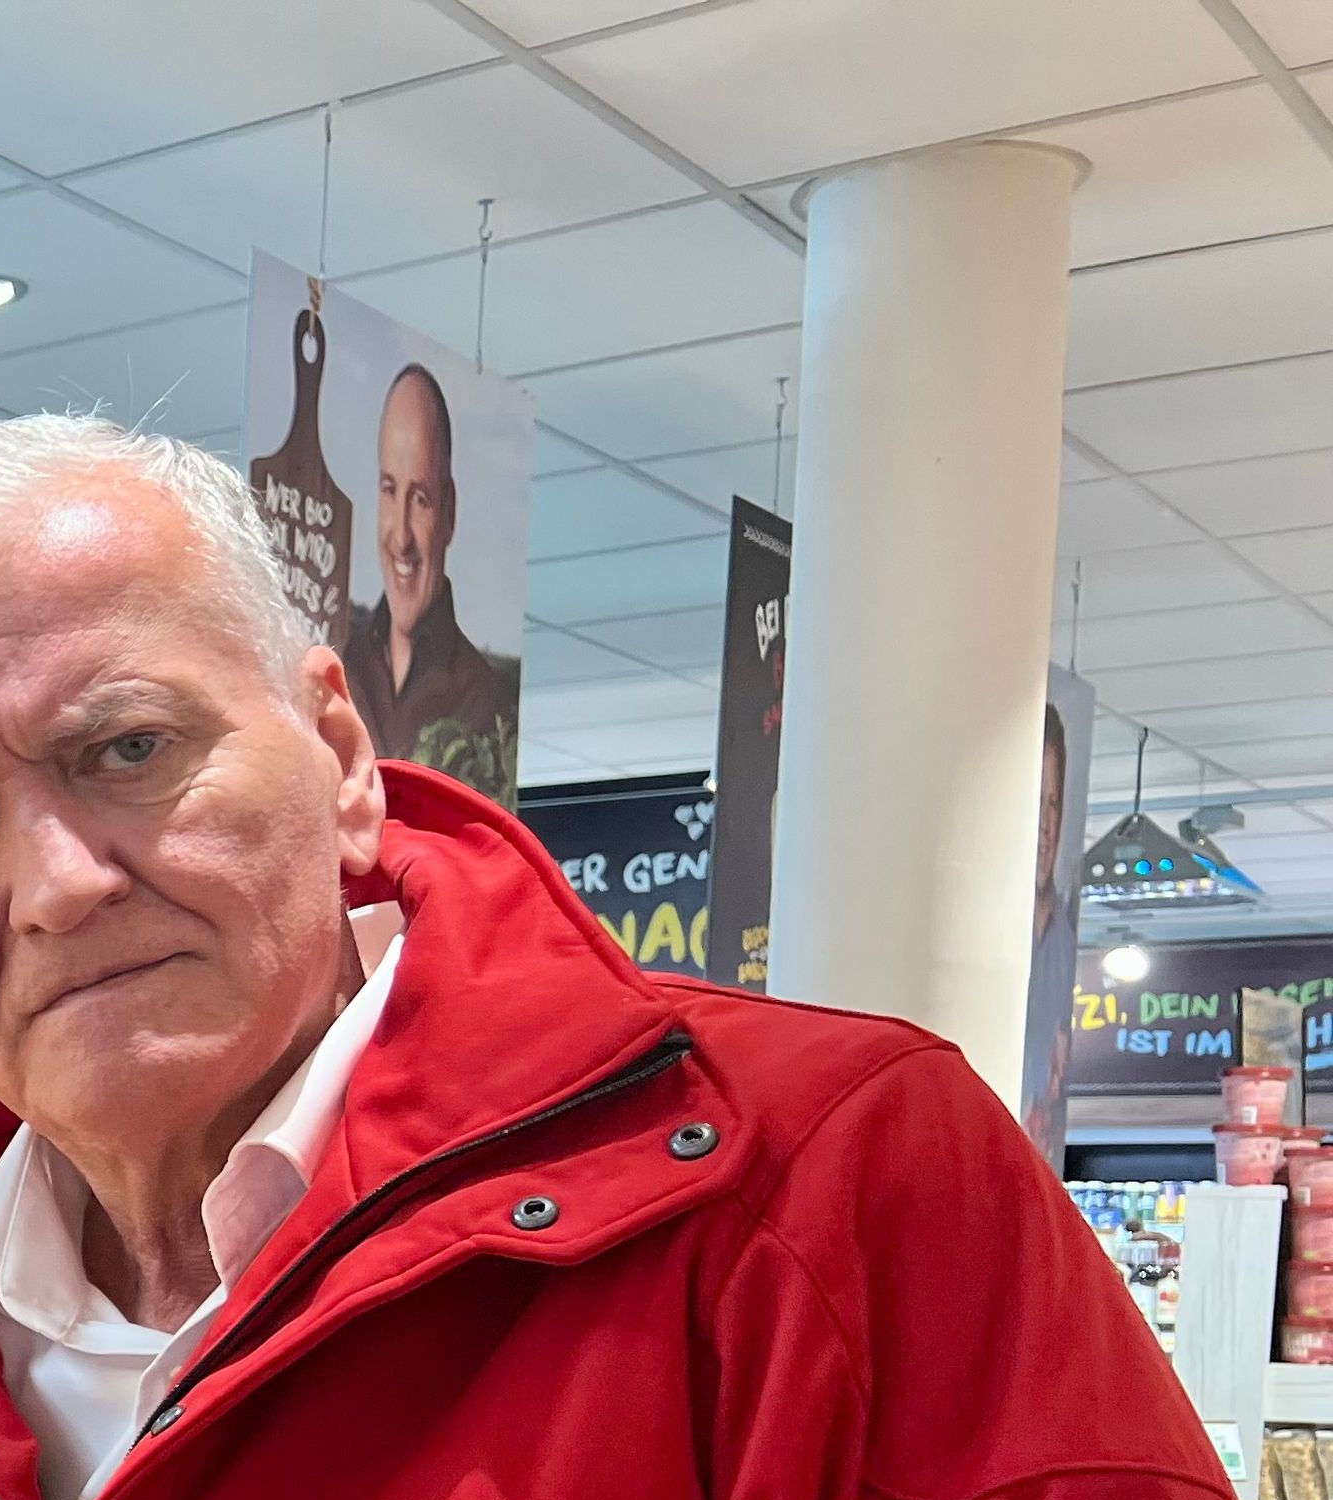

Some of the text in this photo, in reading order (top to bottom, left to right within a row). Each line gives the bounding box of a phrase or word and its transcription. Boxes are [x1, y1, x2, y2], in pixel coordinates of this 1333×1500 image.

[1140, 991, 1220, 1025] DEIN
[1116, 1028, 1173, 1057] IST
[1186, 1028, 1233, 1058] IM
